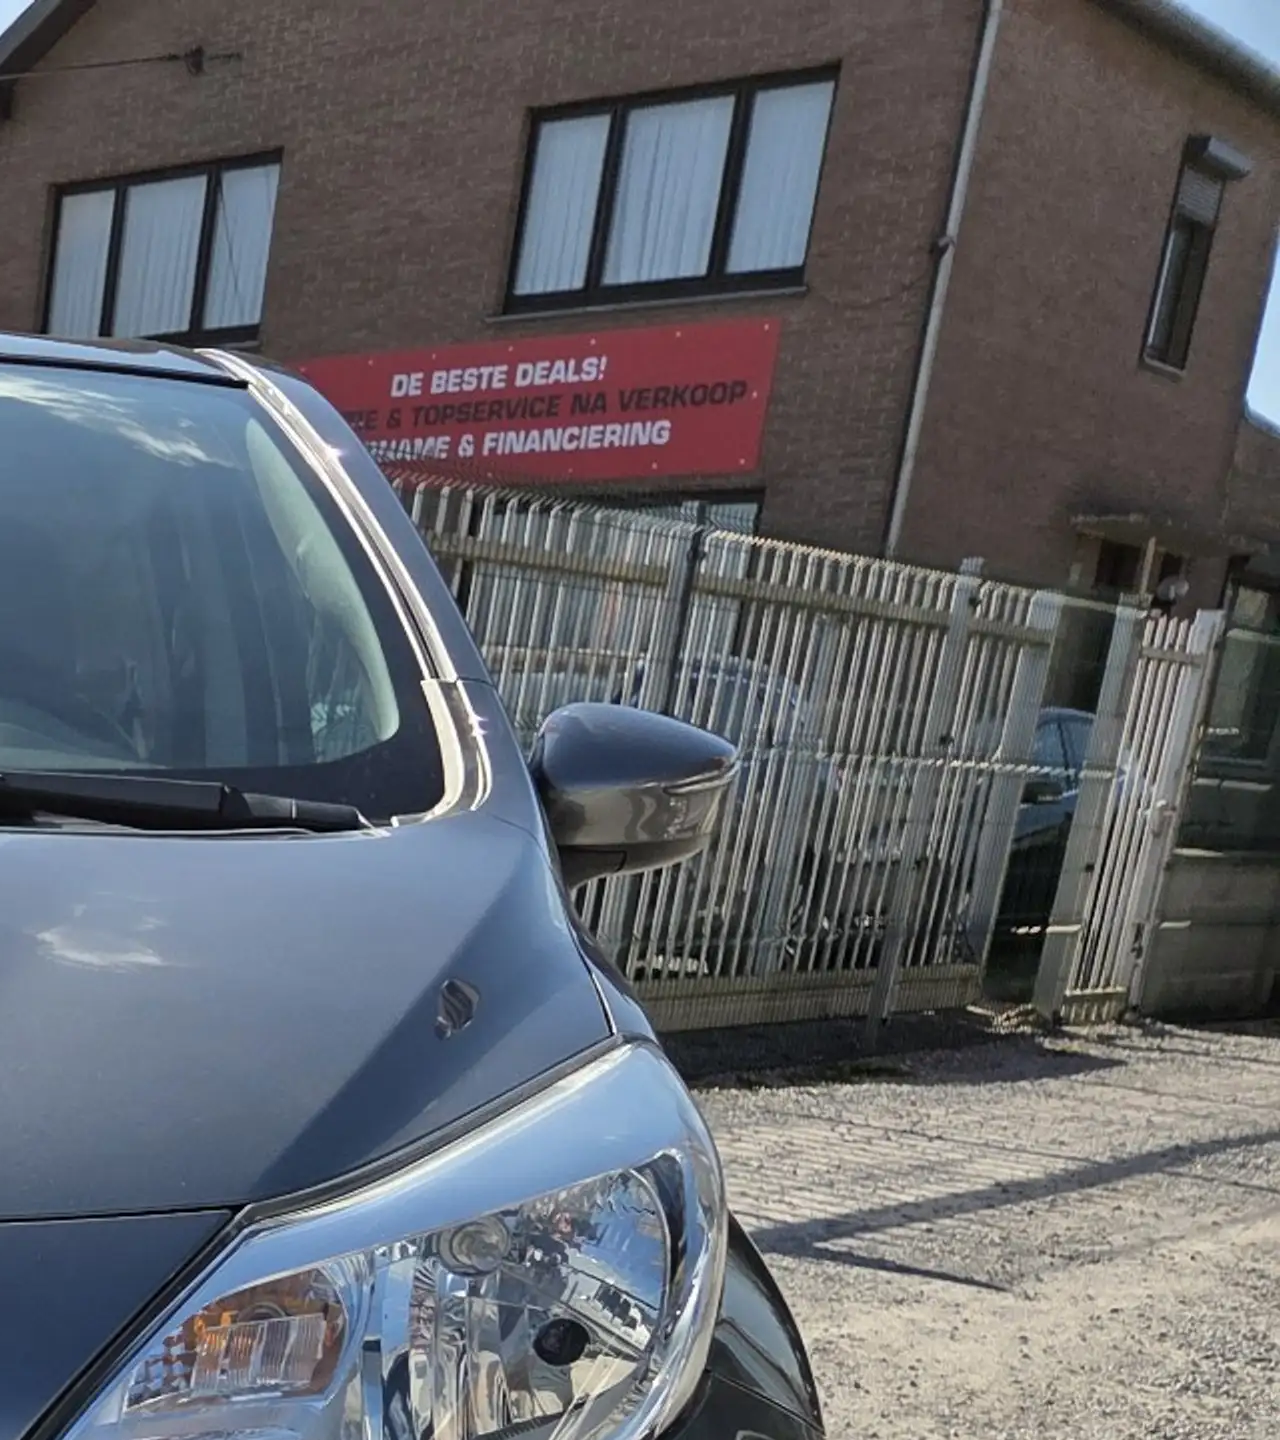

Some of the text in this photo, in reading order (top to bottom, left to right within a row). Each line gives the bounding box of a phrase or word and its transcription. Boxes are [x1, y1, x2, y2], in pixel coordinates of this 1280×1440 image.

[390, 355, 607, 397] DE BESTE DEALS!
[386, 407, 402, 429] &
[412, 394, 561, 427] TOPSERVICE
[571, 392, 606, 416] NA
[619, 380, 747, 413] VERKOOP
[458, 434, 475, 458] &
[482, 420, 672, 456] FINANCIERING
